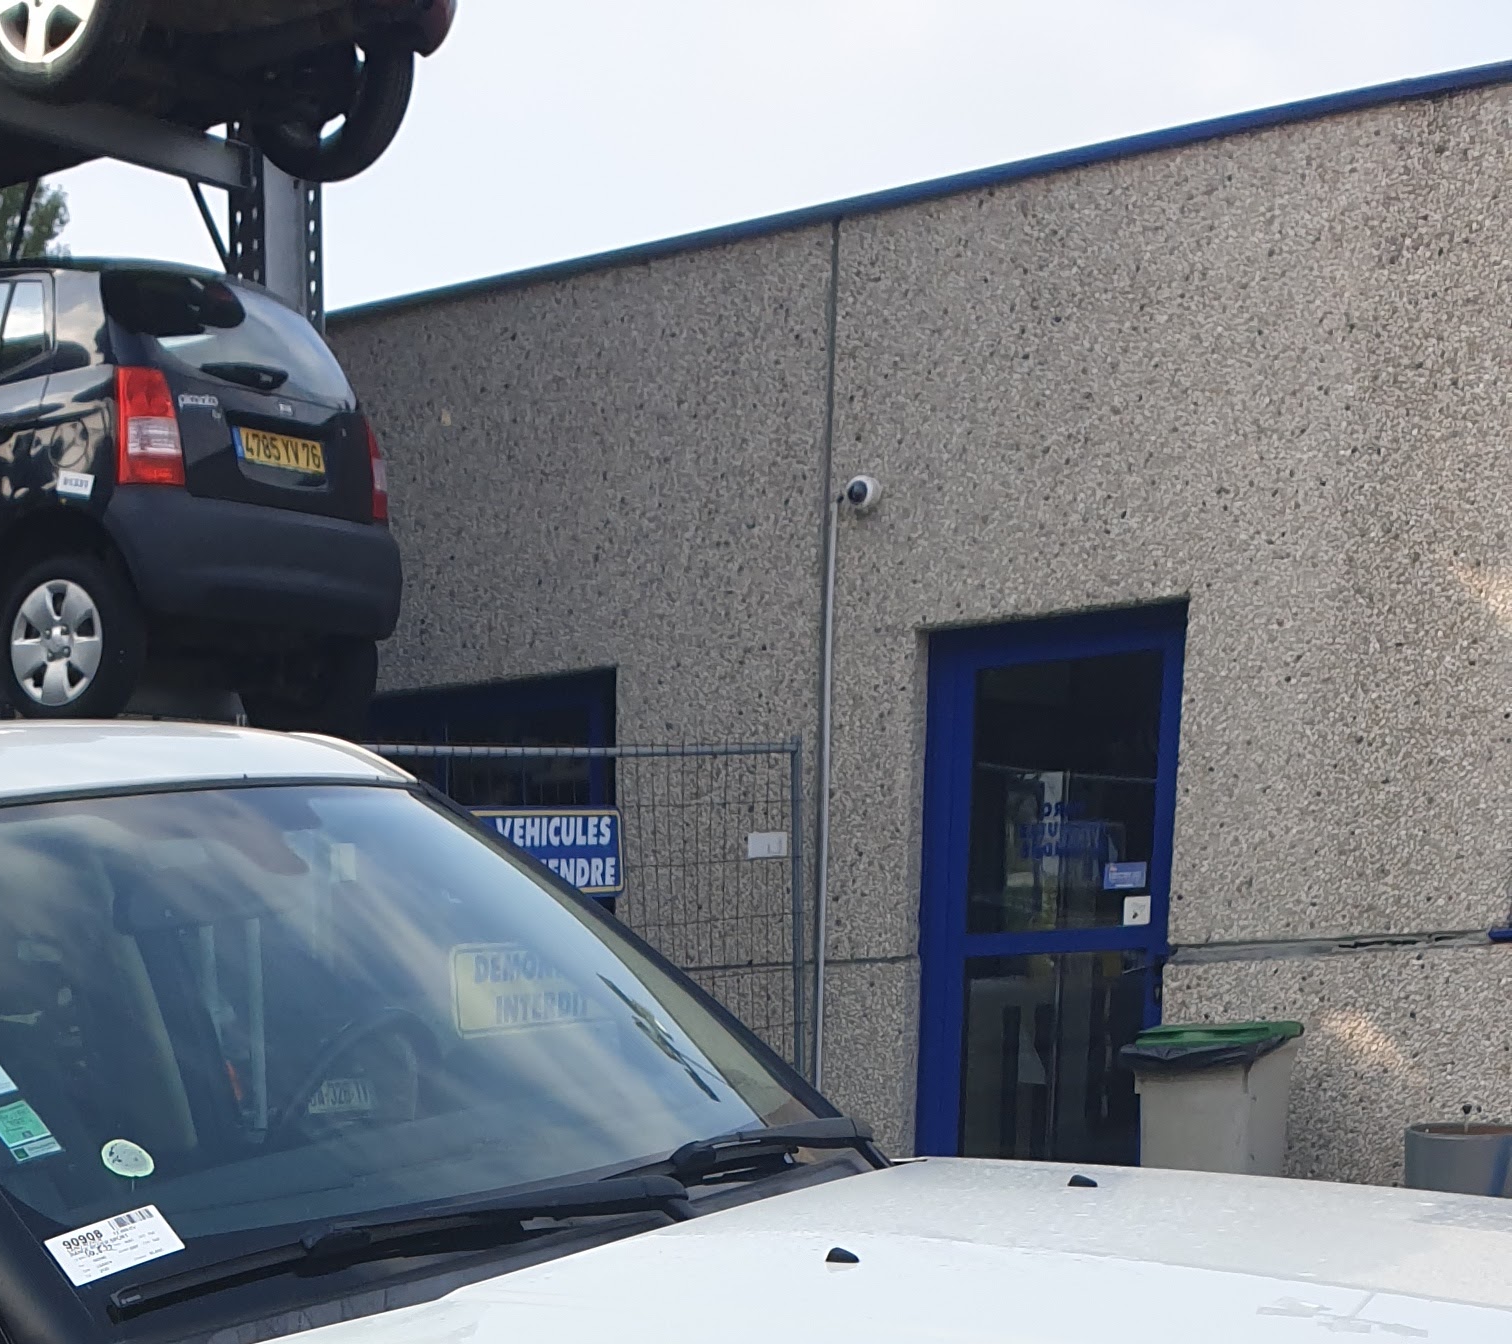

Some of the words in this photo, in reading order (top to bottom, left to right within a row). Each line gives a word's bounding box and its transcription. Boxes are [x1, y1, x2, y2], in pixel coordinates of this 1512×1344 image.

[245, 431, 281, 461] 4785
[302, 443, 322, 469] 76
[495, 816, 612, 847] VEHICULES
[62, 1229, 104, 1250] 90908
